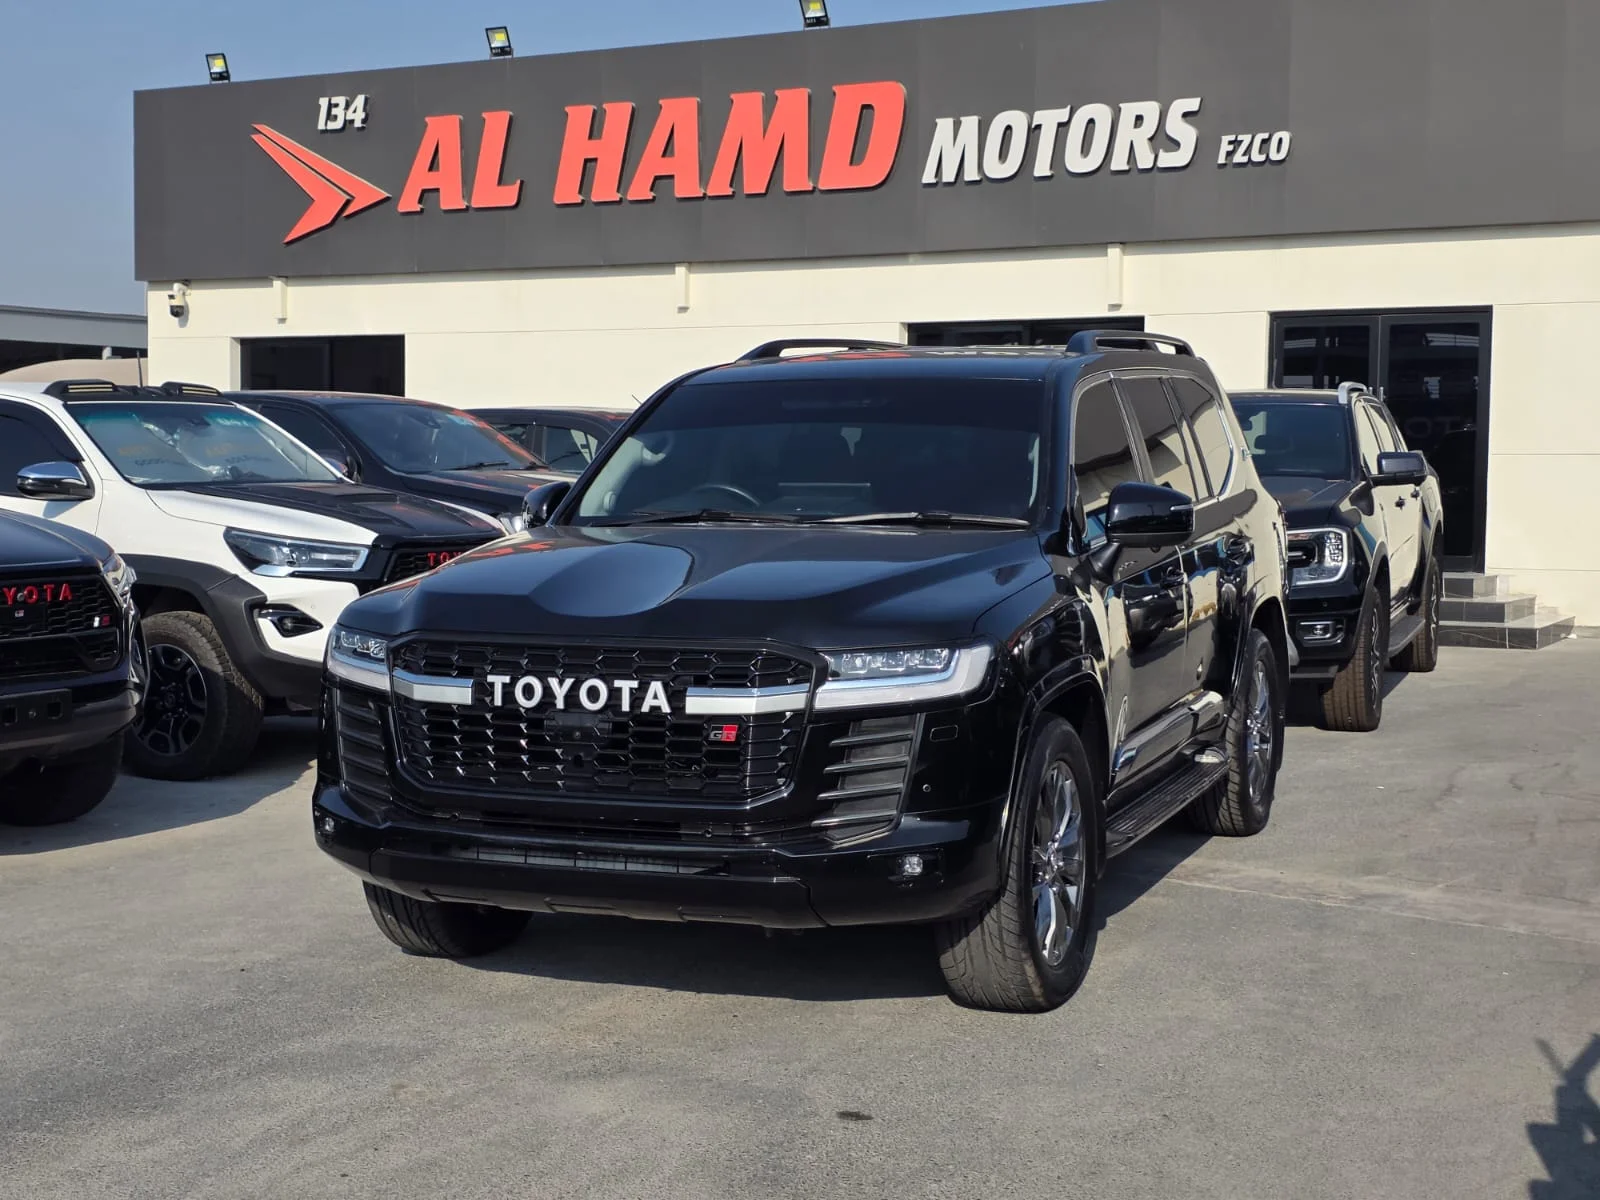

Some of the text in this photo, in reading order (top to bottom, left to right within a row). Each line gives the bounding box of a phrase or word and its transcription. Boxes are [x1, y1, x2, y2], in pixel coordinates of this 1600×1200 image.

[317, 94, 368, 131] 134
[397, 80, 1292, 214] AL HAMD MOTORS FZCO
[486, 674, 672, 714] TOYOTA
[709, 728, 737, 741] GR
